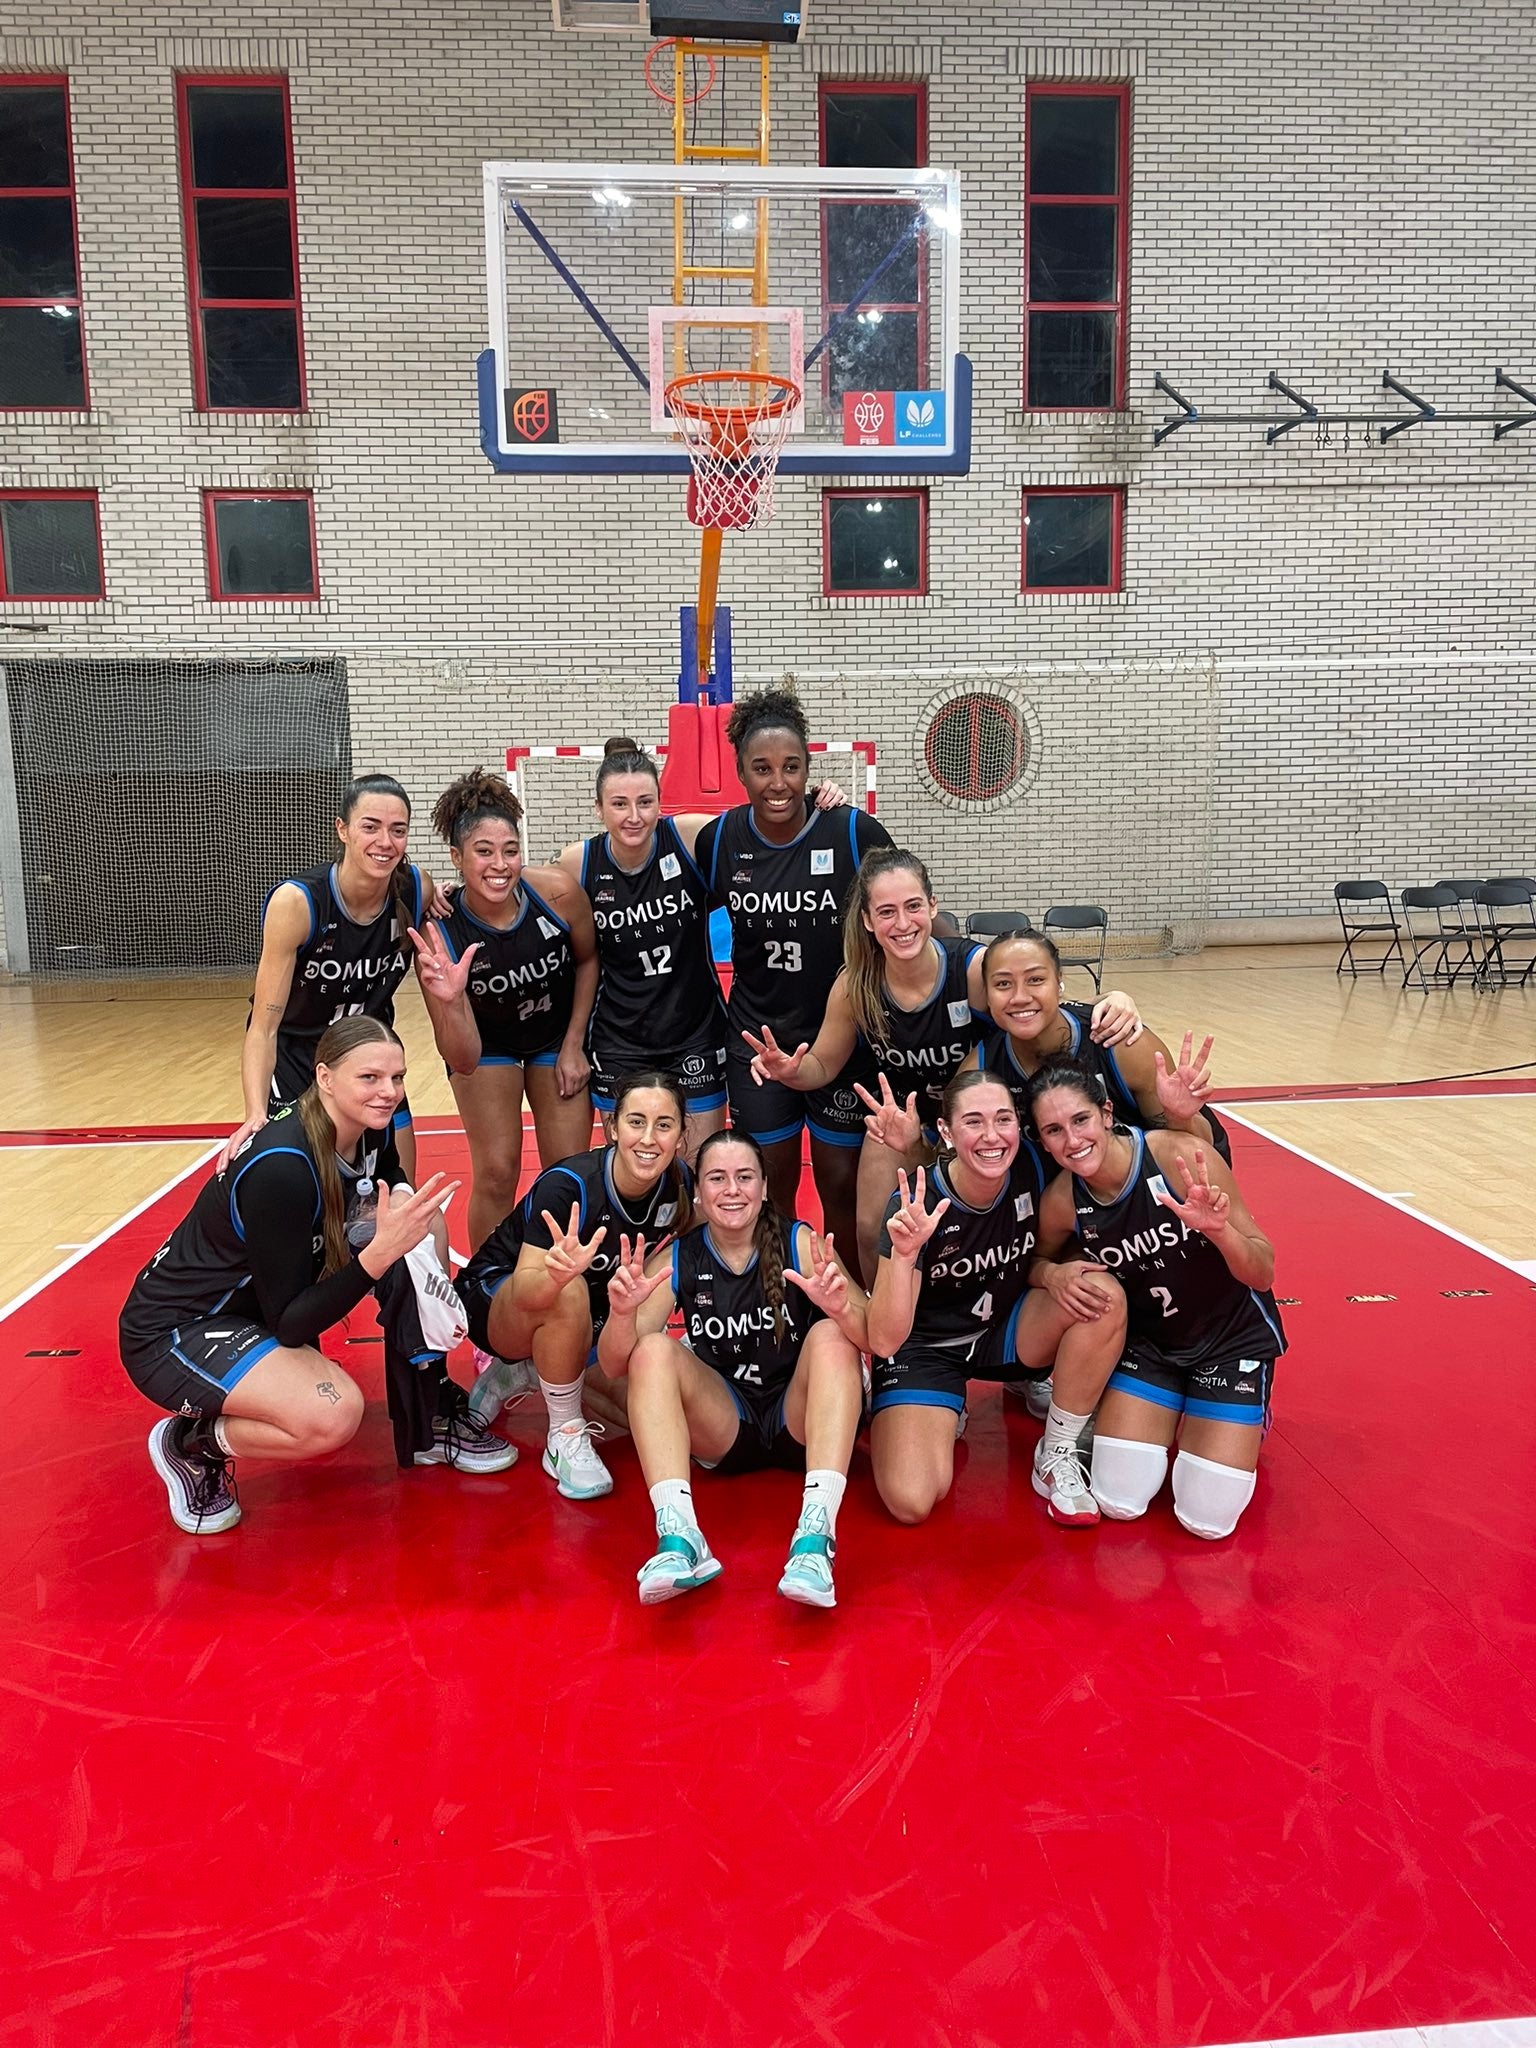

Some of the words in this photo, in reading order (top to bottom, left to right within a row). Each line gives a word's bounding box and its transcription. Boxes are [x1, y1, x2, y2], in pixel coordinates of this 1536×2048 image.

[899, 430, 912, 439] LF
[593, 888, 695, 930] DOMUSA
[728, 888, 838, 914] DOMUSA
[304, 951, 406, 981] DOMUSA
[638, 944, 673, 977] 12
[763, 940, 803, 973] 23
[516, 993, 553, 1021] 24
[871, 1042, 967, 1069] DOMUS
[677, 1073, 716, 1087] AZKOITIA
[930, 1231, 1036, 1280] DOMUSA
[970, 1290, 994, 1322] 4
[1149, 1285, 1179, 1318] 2
